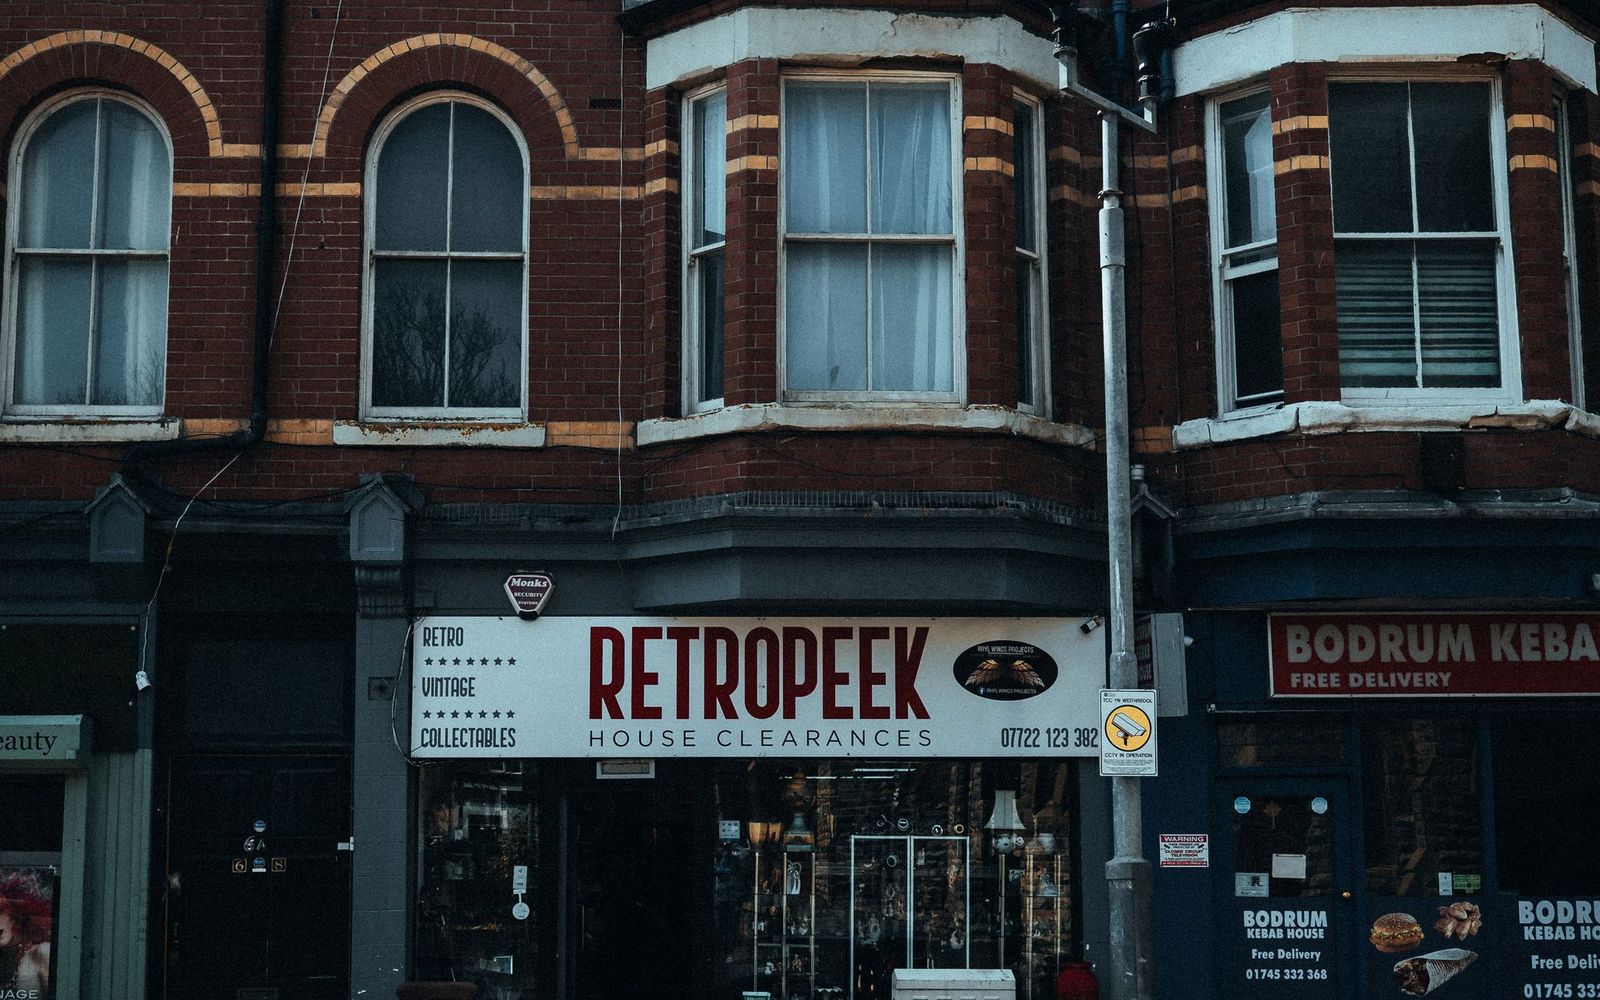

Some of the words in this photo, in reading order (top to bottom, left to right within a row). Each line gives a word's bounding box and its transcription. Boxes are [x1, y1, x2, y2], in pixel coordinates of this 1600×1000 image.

[511, 578, 548, 588] Monks
[423, 626, 464, 646] RETRO
[1286, 623, 1476, 664] BODRUM
[589, 626, 930, 720] RETROPEEK
[1290, 672, 1340, 688] FREE
[1349, 671, 1452, 688] DELIVERY
[422, 677, 475, 697] VINTAGE
[421, 728, 516, 748] COLLECTABLES
[590, 730, 695, 747] HOUSE
[717, 730, 931, 746] CLEARANCES
[1001, 728, 1040, 747] 07722
[1046, 728, 1069, 747] 123
[1074, 728, 1098, 747] 382
[236, 861, 244, 870] 6
[1243, 910, 1328, 927] BODRUM
[1247, 928, 1284, 939] KEBAB
[1287, 928, 1324, 939] HOUSE
[1524, 926, 1576, 940] KEBAB
[1252, 948, 1274, 959] Free
[1278, 948, 1321, 962] Delivery
[1531, 955, 1563, 969] Free
[1246, 969, 1280, 980] 01745
[1284, 969, 1304, 980] 332
[1307, 969, 1328, 980] 368
[1524, 984, 1572, 998] 01745
